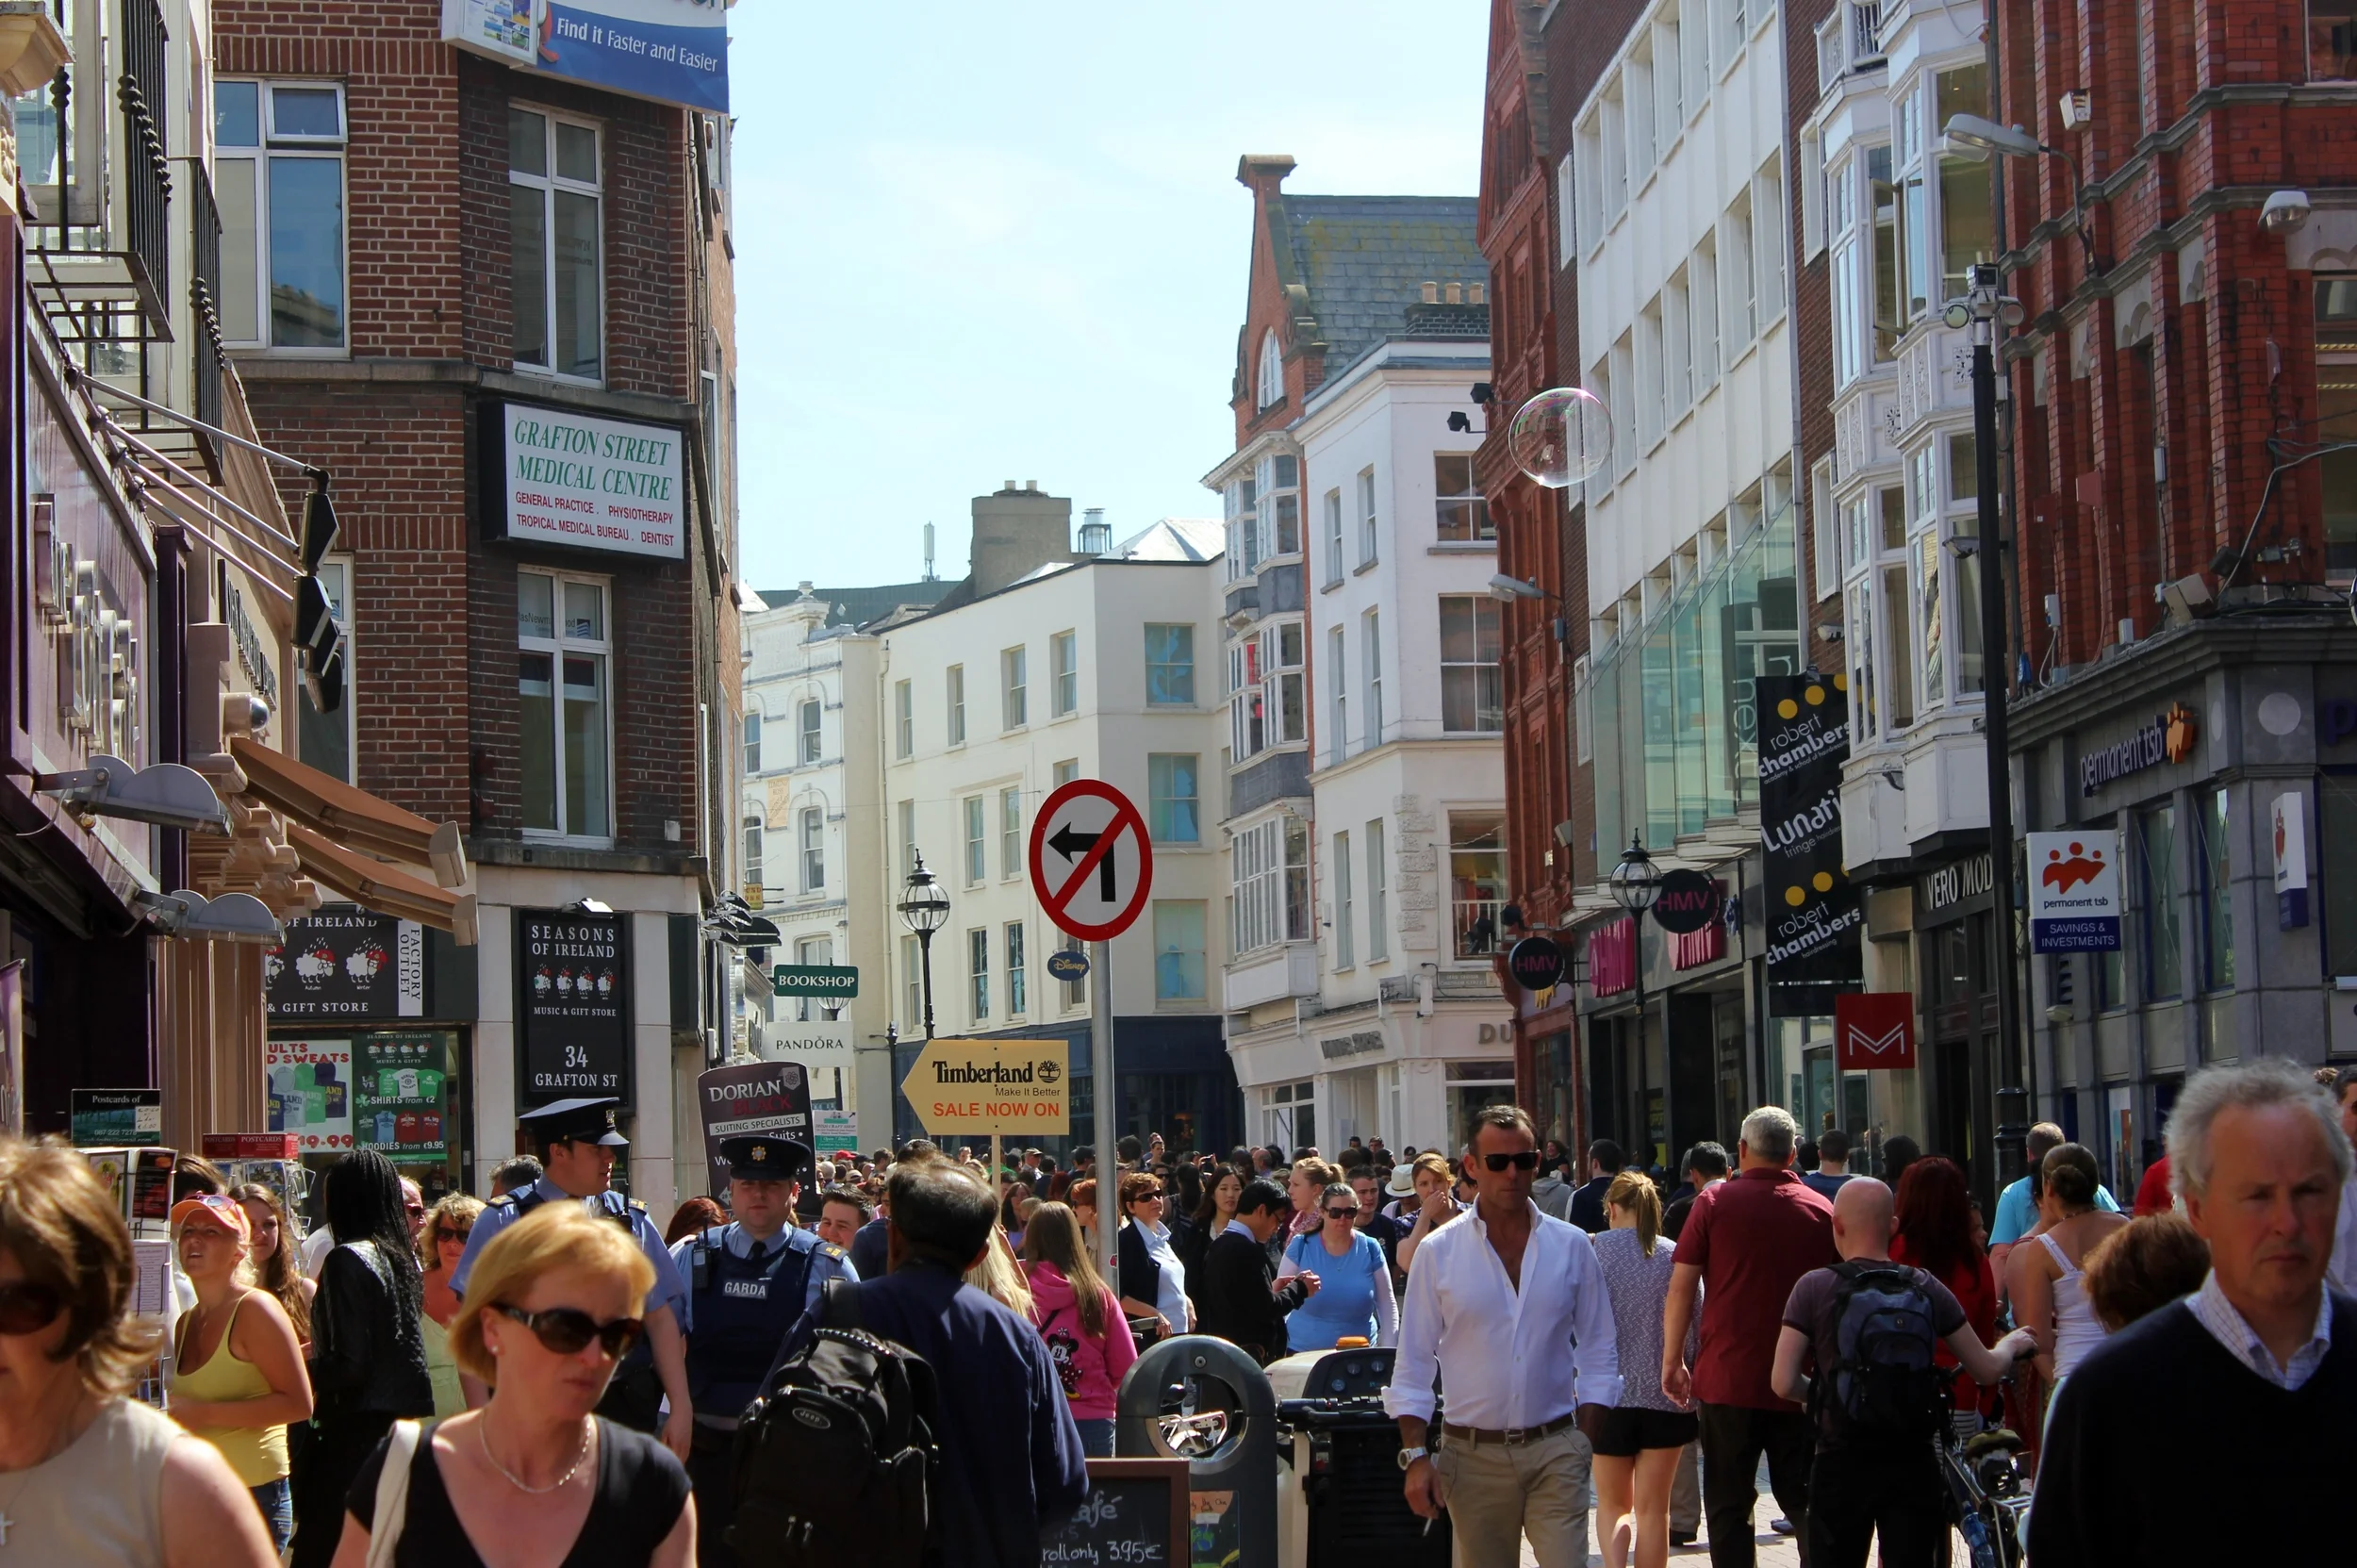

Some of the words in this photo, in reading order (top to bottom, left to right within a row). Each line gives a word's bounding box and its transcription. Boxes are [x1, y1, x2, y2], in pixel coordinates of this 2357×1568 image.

[557, 17, 588, 41] Find
[591, 25, 602, 44] it
[607, 30, 647, 56] Faster
[650, 41, 675, 63] and
[680, 47, 717, 73] Easier
[515, 419, 600, 456] GRAFTON
[602, 434, 671, 467] STREET
[515, 454, 596, 490] MEDICAL
[602, 469, 672, 501] CENTRE
[516, 491, 553, 509] GENERAL
[554, 497, 594, 514] PRACTICE
[608, 505, 673, 525] PHYSIOTHERAPY
[517, 514, 557, 531] TROPICAL
[558, 520, 595, 536] MEDICAL
[597, 525, 629, 541] BUREAU
[641, 531, 674, 547] DENTIST
[1770, 713, 1821, 751] robert
[1758, 721, 1850, 777] chambers
[2080, 728, 2144, 798] permanent
[2143, 715, 2163, 767] tsb
[1764, 768, 1788, 784] academy
[1794, 757, 1812, 769] school
[1784, 837, 1817, 859] fringe
[1926, 866, 1958, 910] VERO
[1657, 890, 1708, 913] HMV
[2044, 899, 2092, 910] permanent
[2094, 897, 2108, 907] tsb
[1778, 900, 1830, 938] robert
[2049, 922, 2095, 933] SAVINGS
[2098, 922, 2106, 933] &
[532, 925, 615, 942] SEASONS
[1765, 907, 1861, 966] chambers
[2041, 934, 2115, 948] INVESTMENTS
[532, 942, 550, 956] OF
[554, 944, 615, 958] IRELAND
[1801, 937, 1838, 959] hairdressing
[400, 933, 410, 996] OUTLET
[410, 929, 421, 999] FACTORY
[1516, 954, 1557, 972] HMV
[778, 974, 855, 988] BOOKSHOP
[267, 1003, 276, 1013] &
[283, 1002, 316, 1013] GIFT
[321, 1002, 369, 1013] STORE
[534, 1006, 560, 1015] MUSIC
[563, 1007, 569, 1015] &
[570, 1007, 589, 1016] GIFT
[591, 1008, 617, 1016] STORE
[776, 1038, 844, 1050] PANDORA
[283, 1053, 350, 1065] SWEATS
[565, 1045, 588, 1068] 34
[535, 1073, 597, 1087] GRAFTON
[602, 1074, 618, 1087] ST
[931, 1060, 1033, 1083] Timberland
[92, 1095, 130, 1104] Postcards
[131, 1095, 141, 1103] of
[425, 1095, 436, 1104] €2
[708, 1080, 782, 1102] DORIAN
[996, 1086, 1021, 1097] Make
[1023, 1086, 1030, 1097] It
[1032, 1087, 1061, 1097] Better
[733, 1094, 794, 1116] BLACK
[933, 1102, 980, 1117] SALE
[985, 1102, 1029, 1117] NOW
[1033, 1102, 1060, 1117] ON
[715, 1121, 749, 1133] SUITING
[750, 1116, 800, 1130] SPECIALISTS
[768, 1131, 796, 1140] Suits
[362, 1142, 400, 1150] HOODIES
[423, 1141, 444, 1149] €9.95
[724, 1280, 766, 1297] GARDA
[1107, 1540, 1163, 1563] 3.95€
